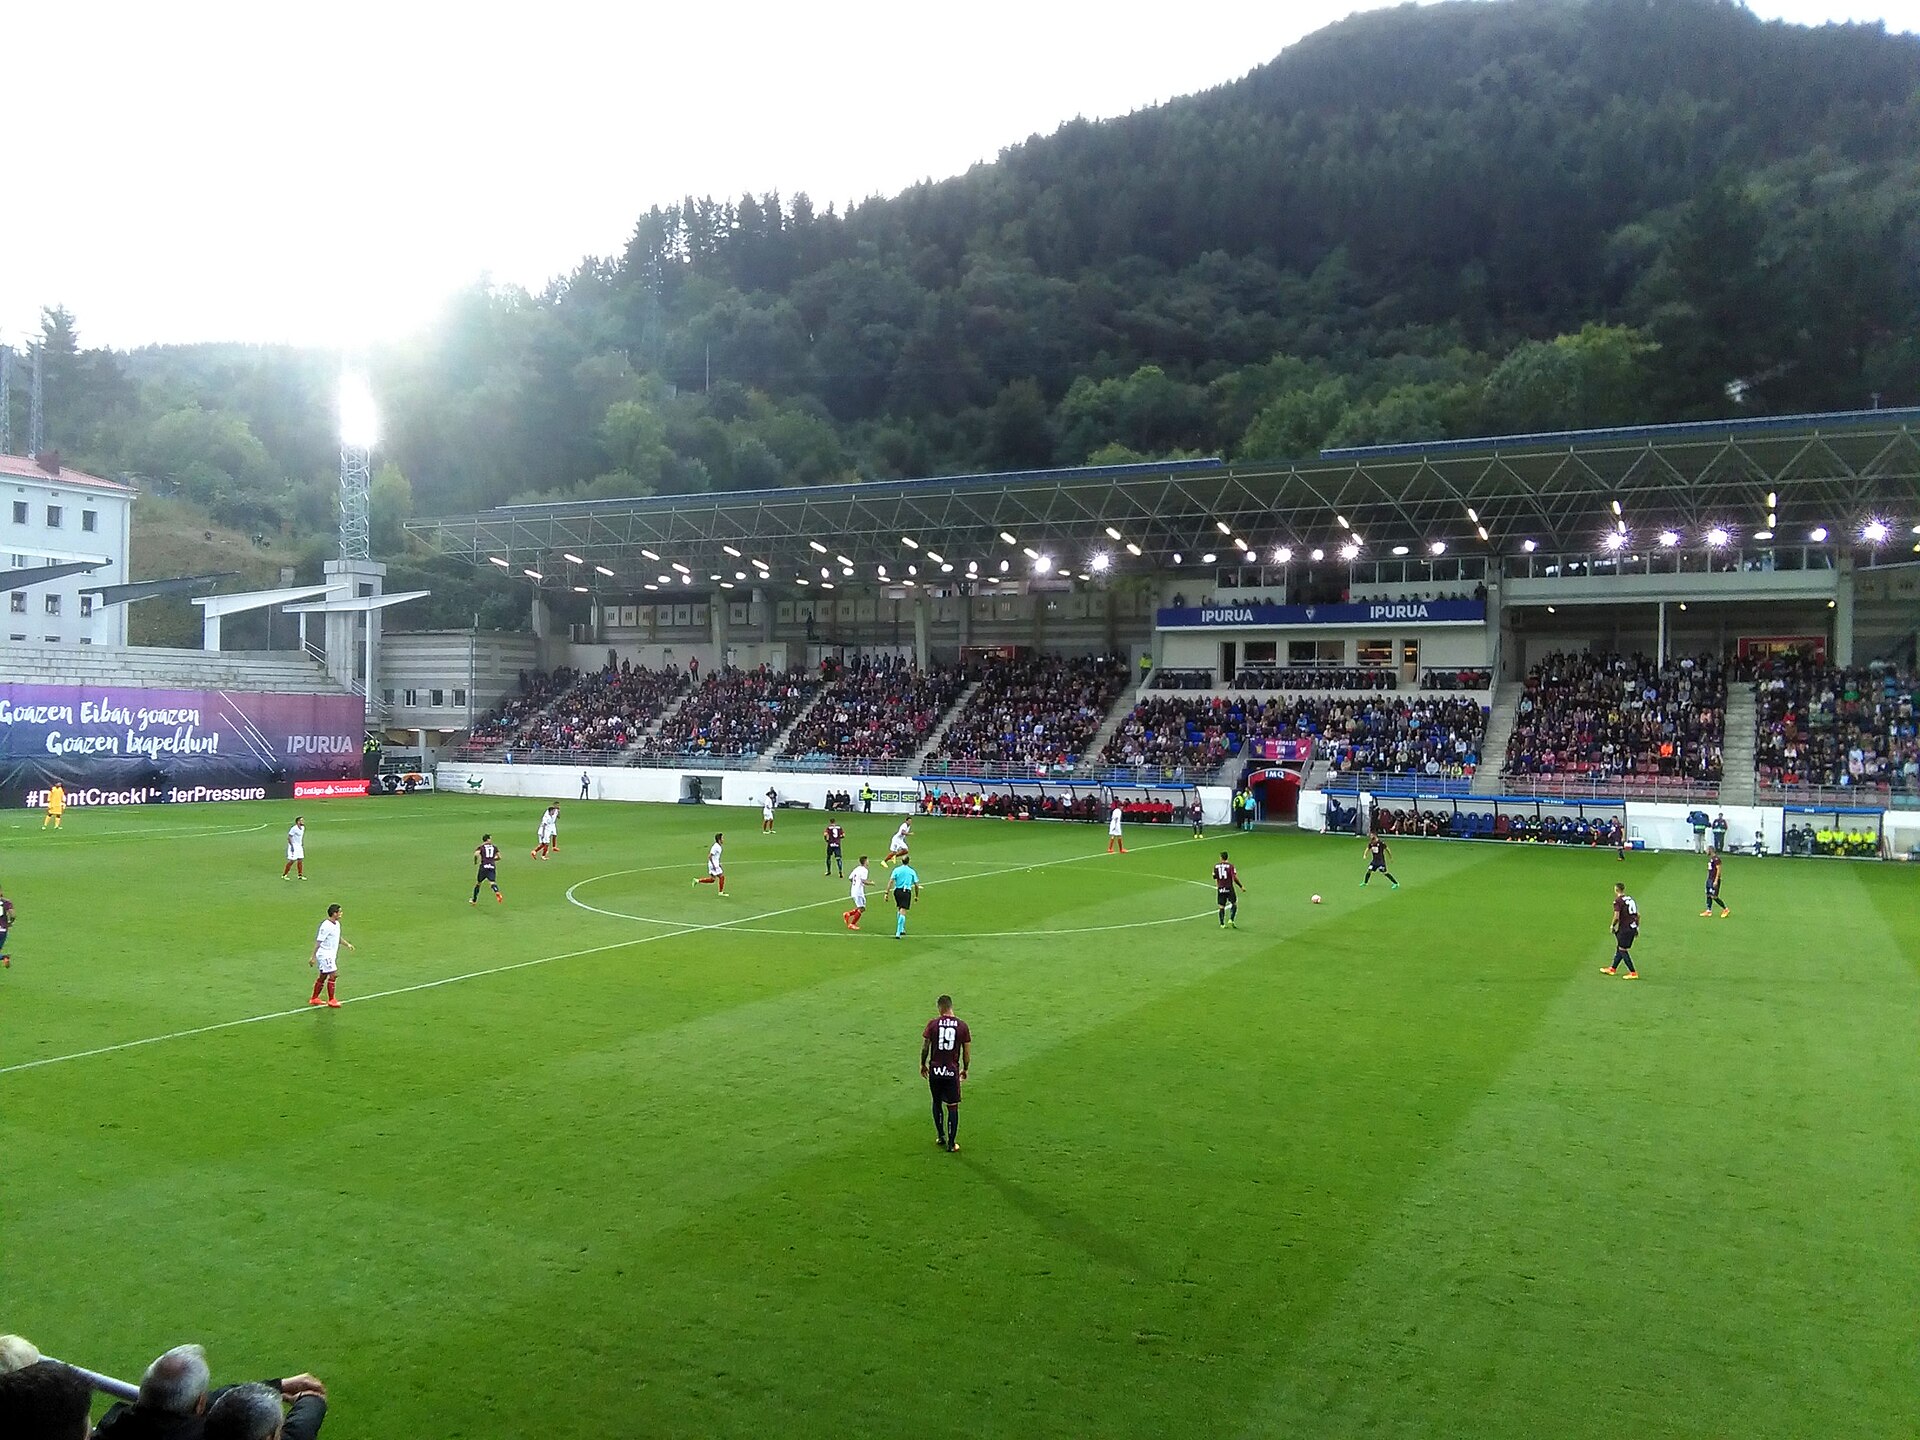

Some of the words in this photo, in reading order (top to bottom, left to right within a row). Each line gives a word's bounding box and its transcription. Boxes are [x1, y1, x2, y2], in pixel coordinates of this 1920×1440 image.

[1201, 609, 1254, 622] IPURUA
[1370, 604, 1428, 618] IPURUA
[0, 700, 72, 725] Goazen
[80, 697, 135, 725] Eibar
[138, 707, 199, 731] goazen
[46, 731, 118, 756] Goazen
[287, 735, 353, 753] IPURUA
[1265, 771, 1285, 779] IMQ
[334, 784, 366, 793] Santande
[938, 1026, 956, 1050] 19
[933, 1065, 955, 1077] Wiko
